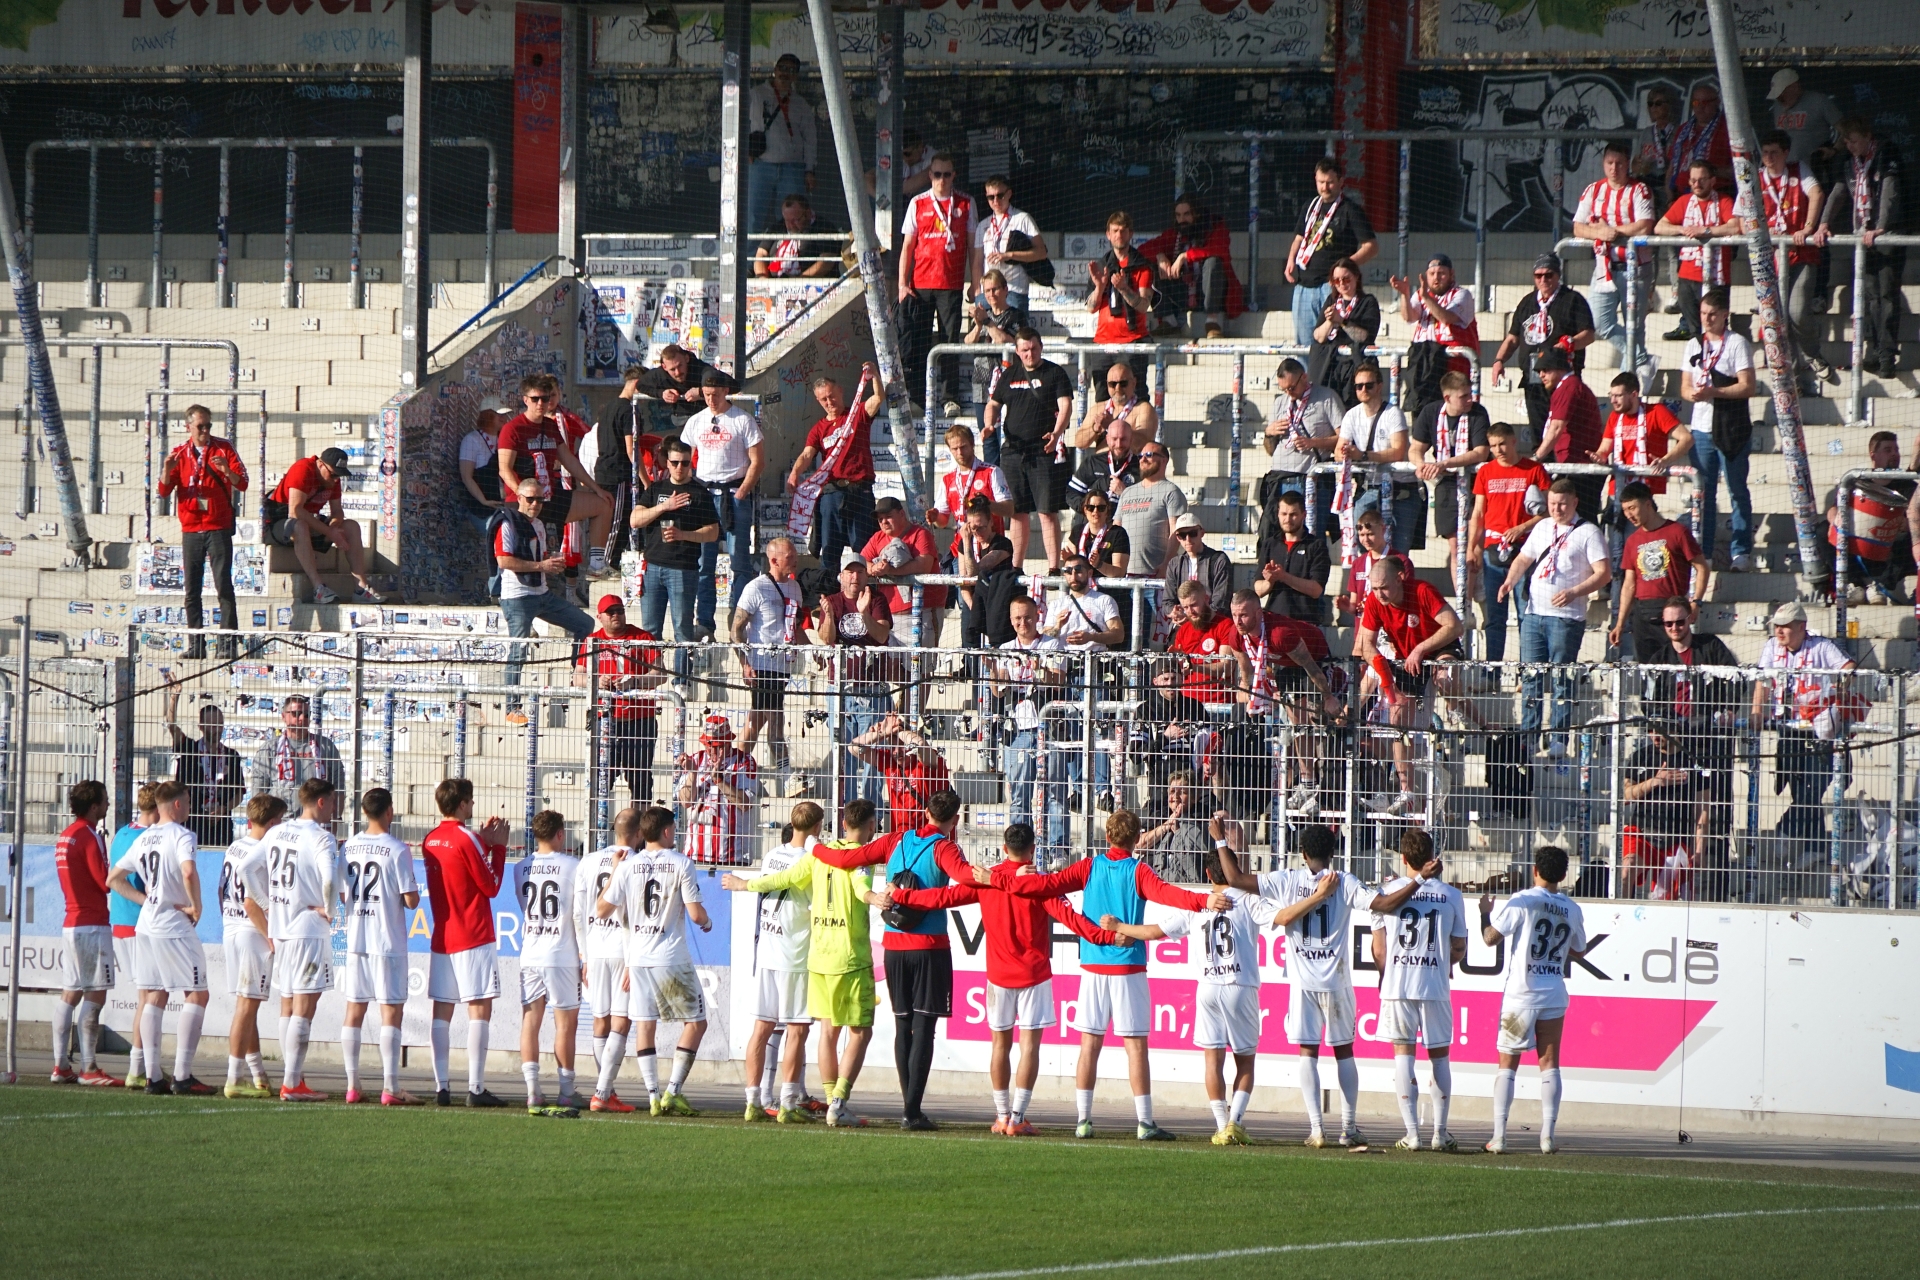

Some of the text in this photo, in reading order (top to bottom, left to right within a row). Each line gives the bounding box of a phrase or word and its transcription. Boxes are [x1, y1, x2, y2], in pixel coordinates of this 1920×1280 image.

[622, 239, 691, 250] RUPPERT
[590, 264, 661, 276] RUPPERT
[344, 845, 391, 857] BREITFELDER
[140, 851, 160, 890] 19
[270, 846, 298, 890] 25
[523, 866, 561, 876] PODOLSKI
[348, 861, 382, 903] 22
[827, 869, 835, 911] 1
[522, 880, 561, 922] 26
[643, 878, 662, 921] 6
[1544, 902, 1569, 918] NAJJAR
[813, 916, 847, 928] POLYMA
[1398, 906, 1439, 951] 31
[1201, 915, 1236, 962] 13
[1531, 918, 1571, 963] 32
[1204, 962, 1242, 976] POLYMA
[1393, 955, 1438, 967] POLYMA
[1527, 964, 1562, 976] POLYMA
[111, 1000, 137, 1010] Ticket
